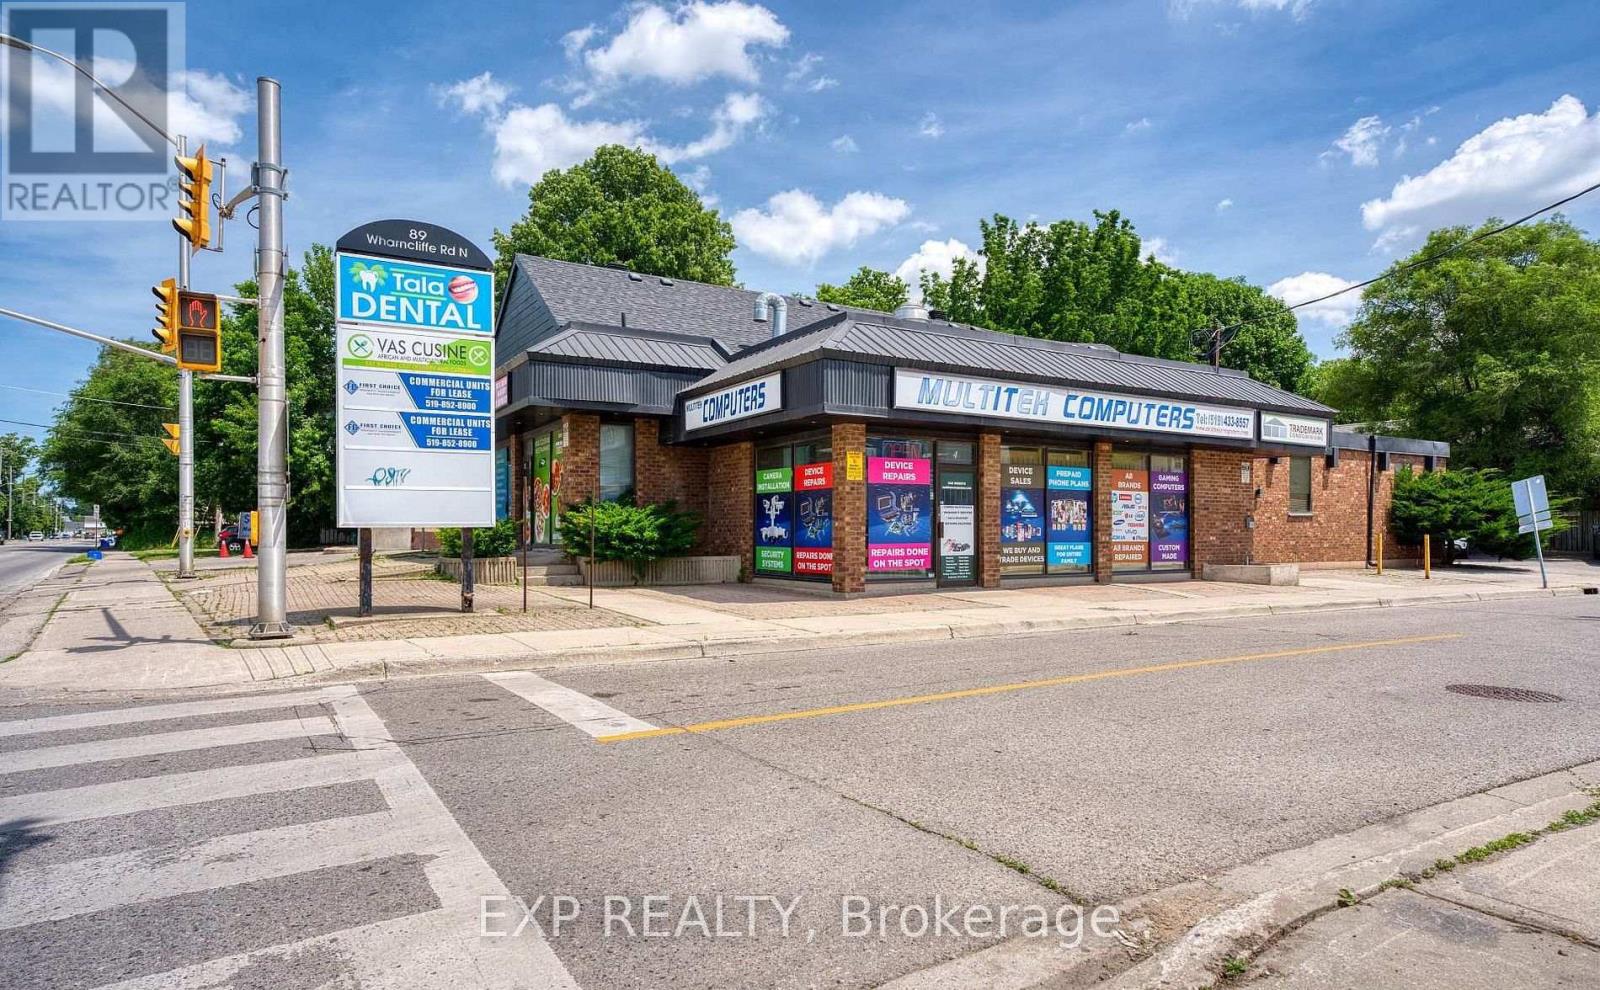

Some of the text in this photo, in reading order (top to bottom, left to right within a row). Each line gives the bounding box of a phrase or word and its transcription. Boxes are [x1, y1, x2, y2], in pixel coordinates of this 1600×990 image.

[408, 229, 427, 240] 89
[366, 233, 468, 258] Wharncliffe Rd N
[392, 272, 444, 296] Tala
[352, 291, 481, 329] DENTAL
[377, 338, 467, 360] VAS CUSINE
[409, 377, 490, 391] COMMERCIAL UNITS
[430, 388, 472, 399] FOR LEASE
[703, 382, 766, 422] COMPUTERS
[1062, 394, 1197, 430] COMPUTERS
[410, 416, 491, 428] COMMERCIAL UNITS
[431, 427, 473, 437] FOR LEASE
[1289, 424, 1323, 435] TRADEMARK
[426, 439, 477, 448] 519-852-8900
[884, 461, 913, 469] DEVICE
[804, 466, 824, 476] DEVICE
[1008, 466, 1033, 474] DEVICE
[1056, 470, 1082, 478] PREPAID
[763, 472, 782, 480] CAMERA
[882, 472, 916, 480] REPAIRS
[1158, 474, 1179, 482] GAMING
[757, 481, 790, 490] INSTALLATION
[803, 477, 825, 487] REPAIRS
[1010, 477, 1032, 485] SALES
[1117, 481, 1142, 489] BRANDS
[1153, 483, 1185, 491] COMPUTERS
[871, 548, 929, 556] REPAIRS DONE
[1121, 544, 1145, 552] BRANDS
[761, 550, 784, 558] SECURITY
[796, 551, 818, 560] REPAIRS
[1114, 553, 1143, 561] REPAIRED
[1161, 552, 1178, 560] MADE
[762, 560, 784, 569] SYSTEMS
[797, 561, 832, 571] ON THE SPOT
[887, 559, 903, 567] THE
[905, 559, 925, 567] SPOT
